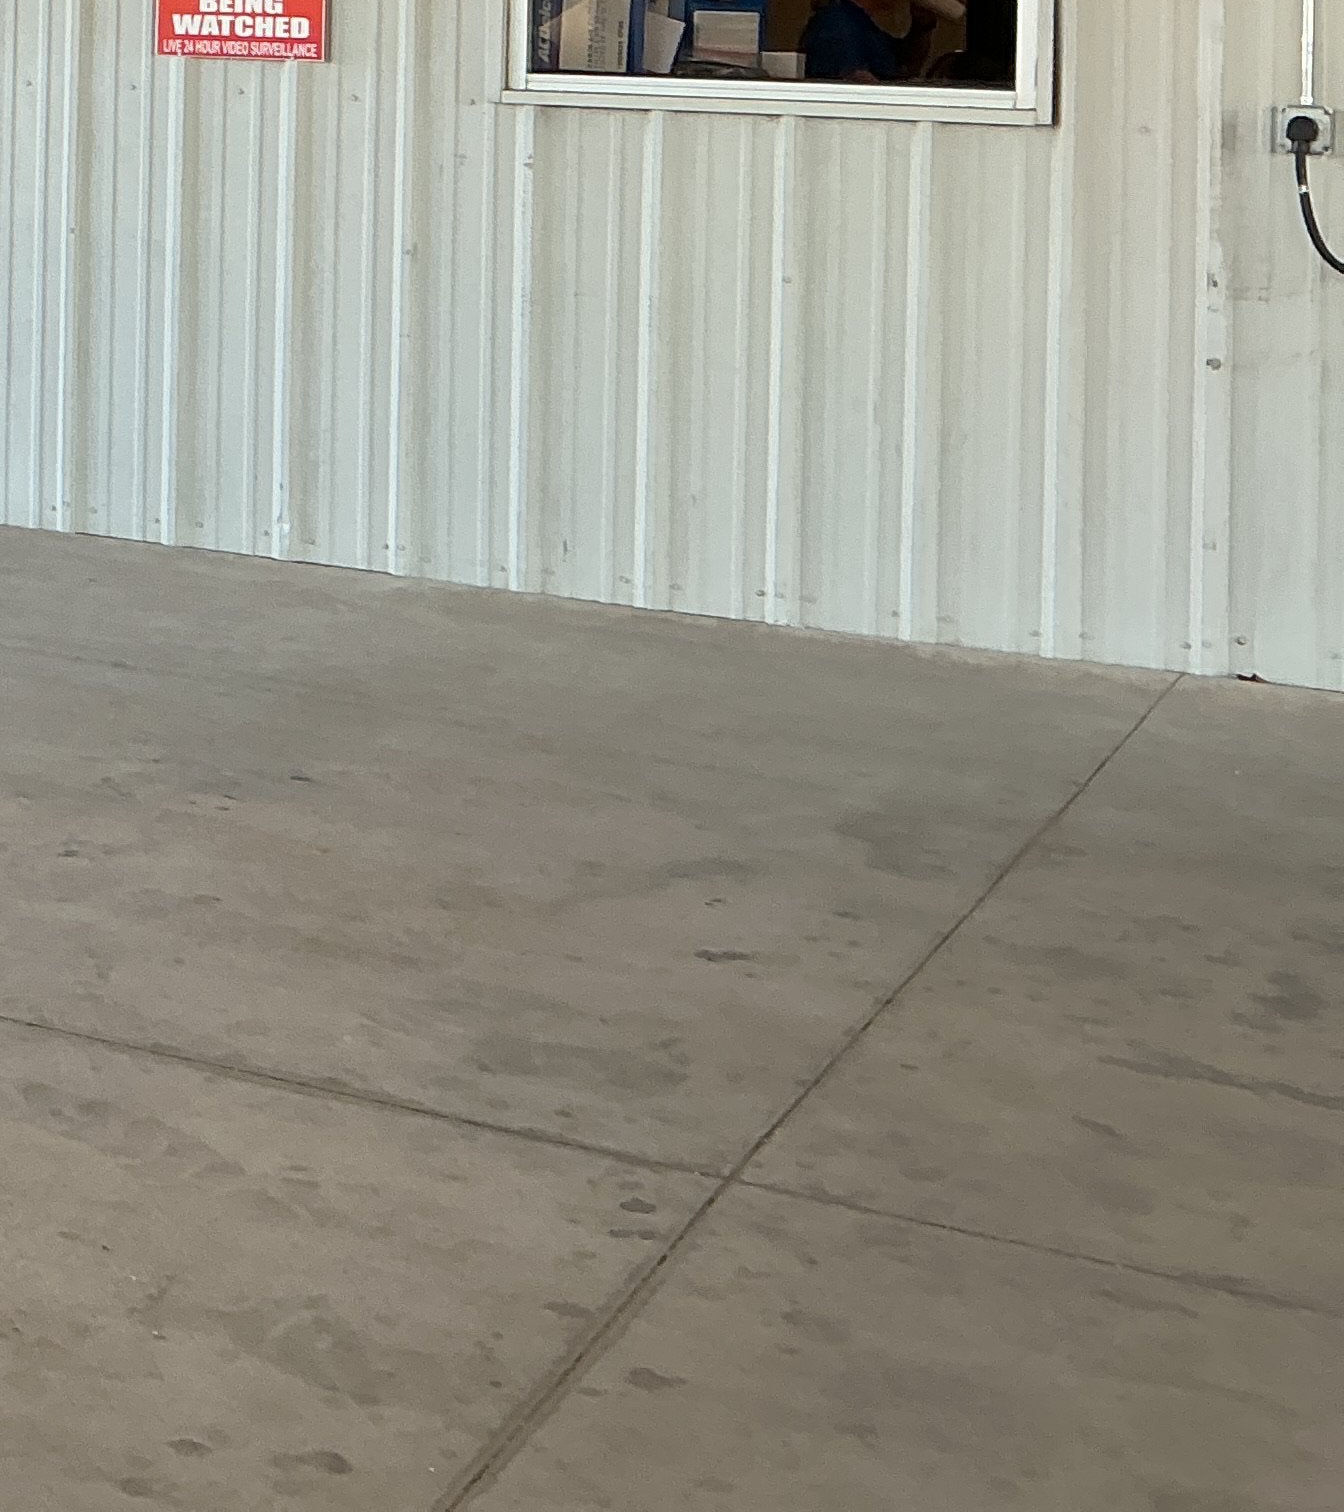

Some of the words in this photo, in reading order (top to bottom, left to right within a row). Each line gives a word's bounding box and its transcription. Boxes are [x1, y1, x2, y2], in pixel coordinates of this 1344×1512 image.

[172, 13, 311, 39] WATCHED
[162, 39, 182, 53] LIVE
[183, 39, 194, 54] 24
[195, 40, 221, 55] HOUR
[222, 41, 249, 56] VIDEO
[249, 41, 318, 58] SURVEILLANCE
